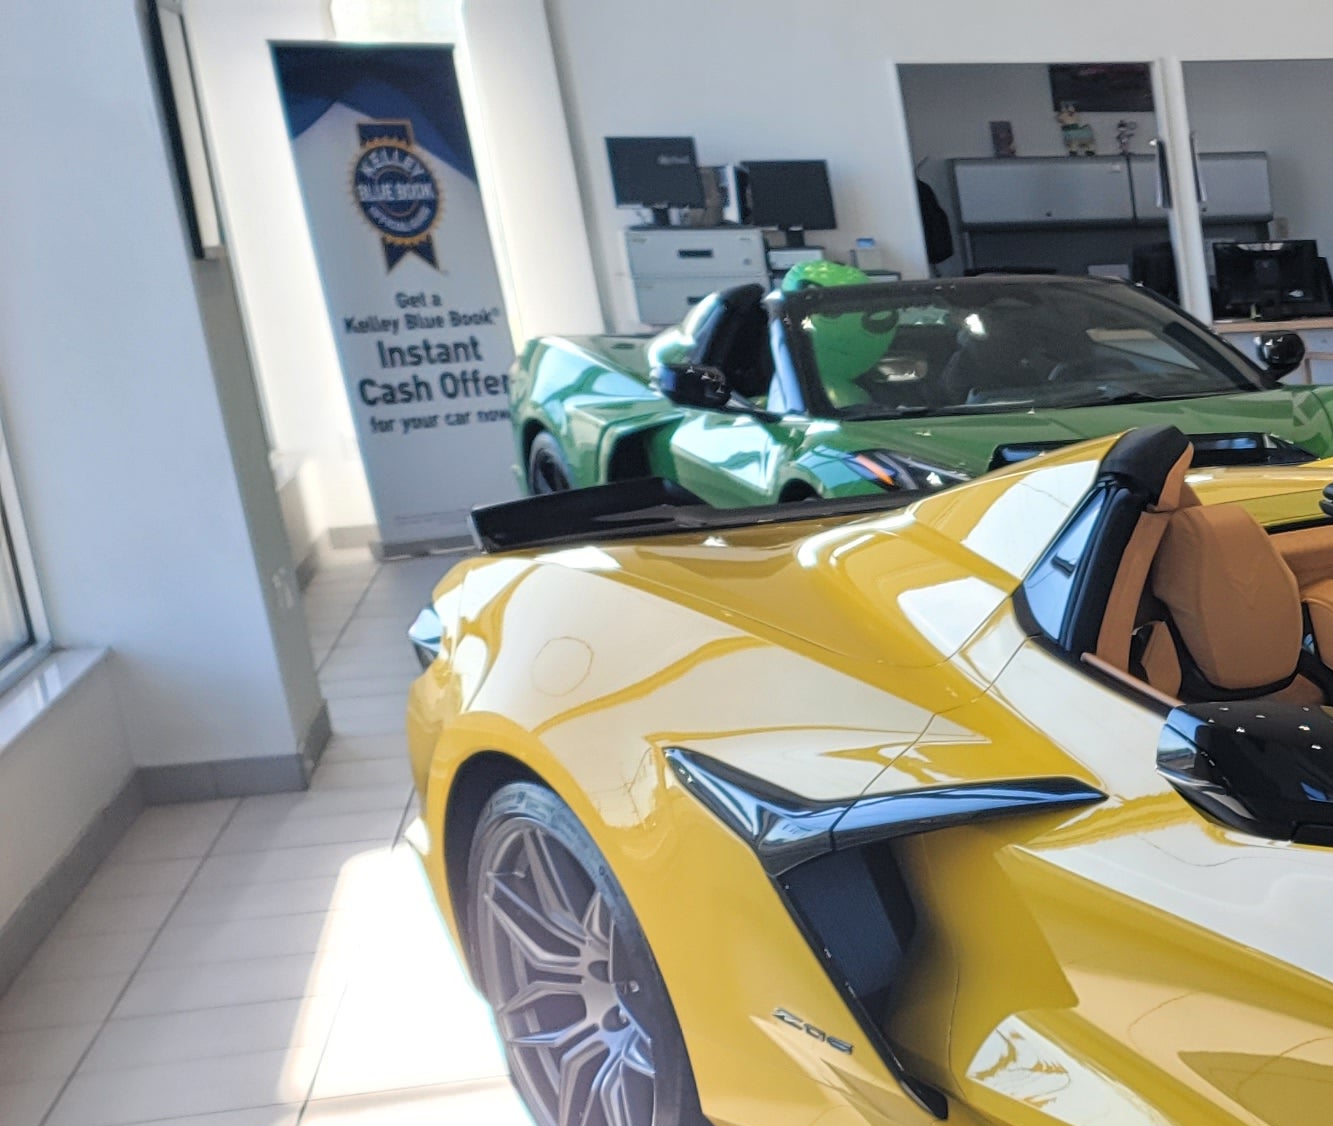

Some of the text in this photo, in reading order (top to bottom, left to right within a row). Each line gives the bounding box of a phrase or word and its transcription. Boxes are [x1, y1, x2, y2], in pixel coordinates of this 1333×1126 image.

[361, 148, 425, 178] KELLEY
[358, 182, 435, 201] BLUE BOOK
[395, 291, 442, 309] Get a
[344, 315, 399, 335] Kelley
[404, 312, 444, 330] Blue
[377, 335, 483, 368] Instant
[359, 369, 510, 406] Cash Offer
[370, 415, 395, 433] for
[402, 414, 440, 434] your
[445, 411, 472, 427] car
